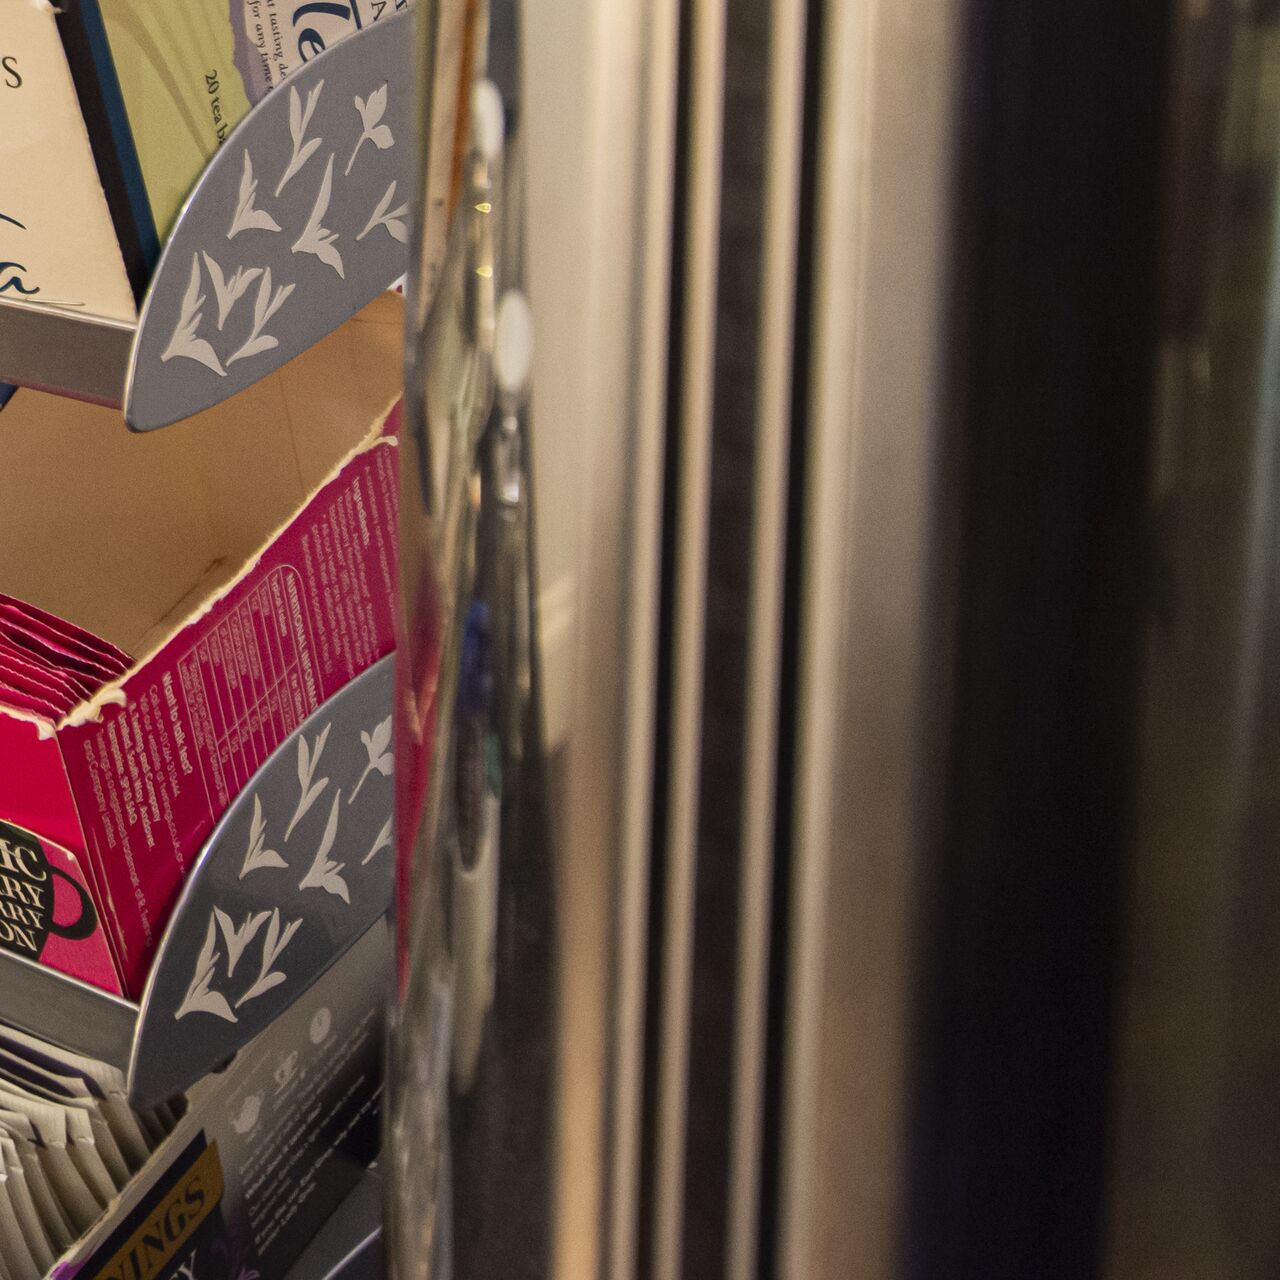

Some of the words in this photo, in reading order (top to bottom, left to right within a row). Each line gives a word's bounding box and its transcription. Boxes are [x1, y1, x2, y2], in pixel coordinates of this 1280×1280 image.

[247, 0, 261, 15] for
[255, 22, 266, 50] any
[269, 9, 284, 62] tasting
[204, 69, 219, 94] 20
[260, 52, 272, 83] time
[211, 96, 222, 124] tea
[278, 606, 287, 636] Values
[287, 574, 305, 650] NUTRITIONAL
[157, 719, 164, 734] on
[163, 672, 175, 706] Want
[170, 706, 178, 721] to
[174, 721, 184, 746] talk
[179, 746, 192, 775] tea?
[144, 715, 152, 731] our
[149, 733, 160, 770] website
[127, 750, 138, 780] South
[132, 714, 143, 752] Twining
[140, 752, 150, 773] and
[145, 772, 160, 821] Company
[89, 760, 105, 811] Company
[123, 837, 138, 886] trademark
